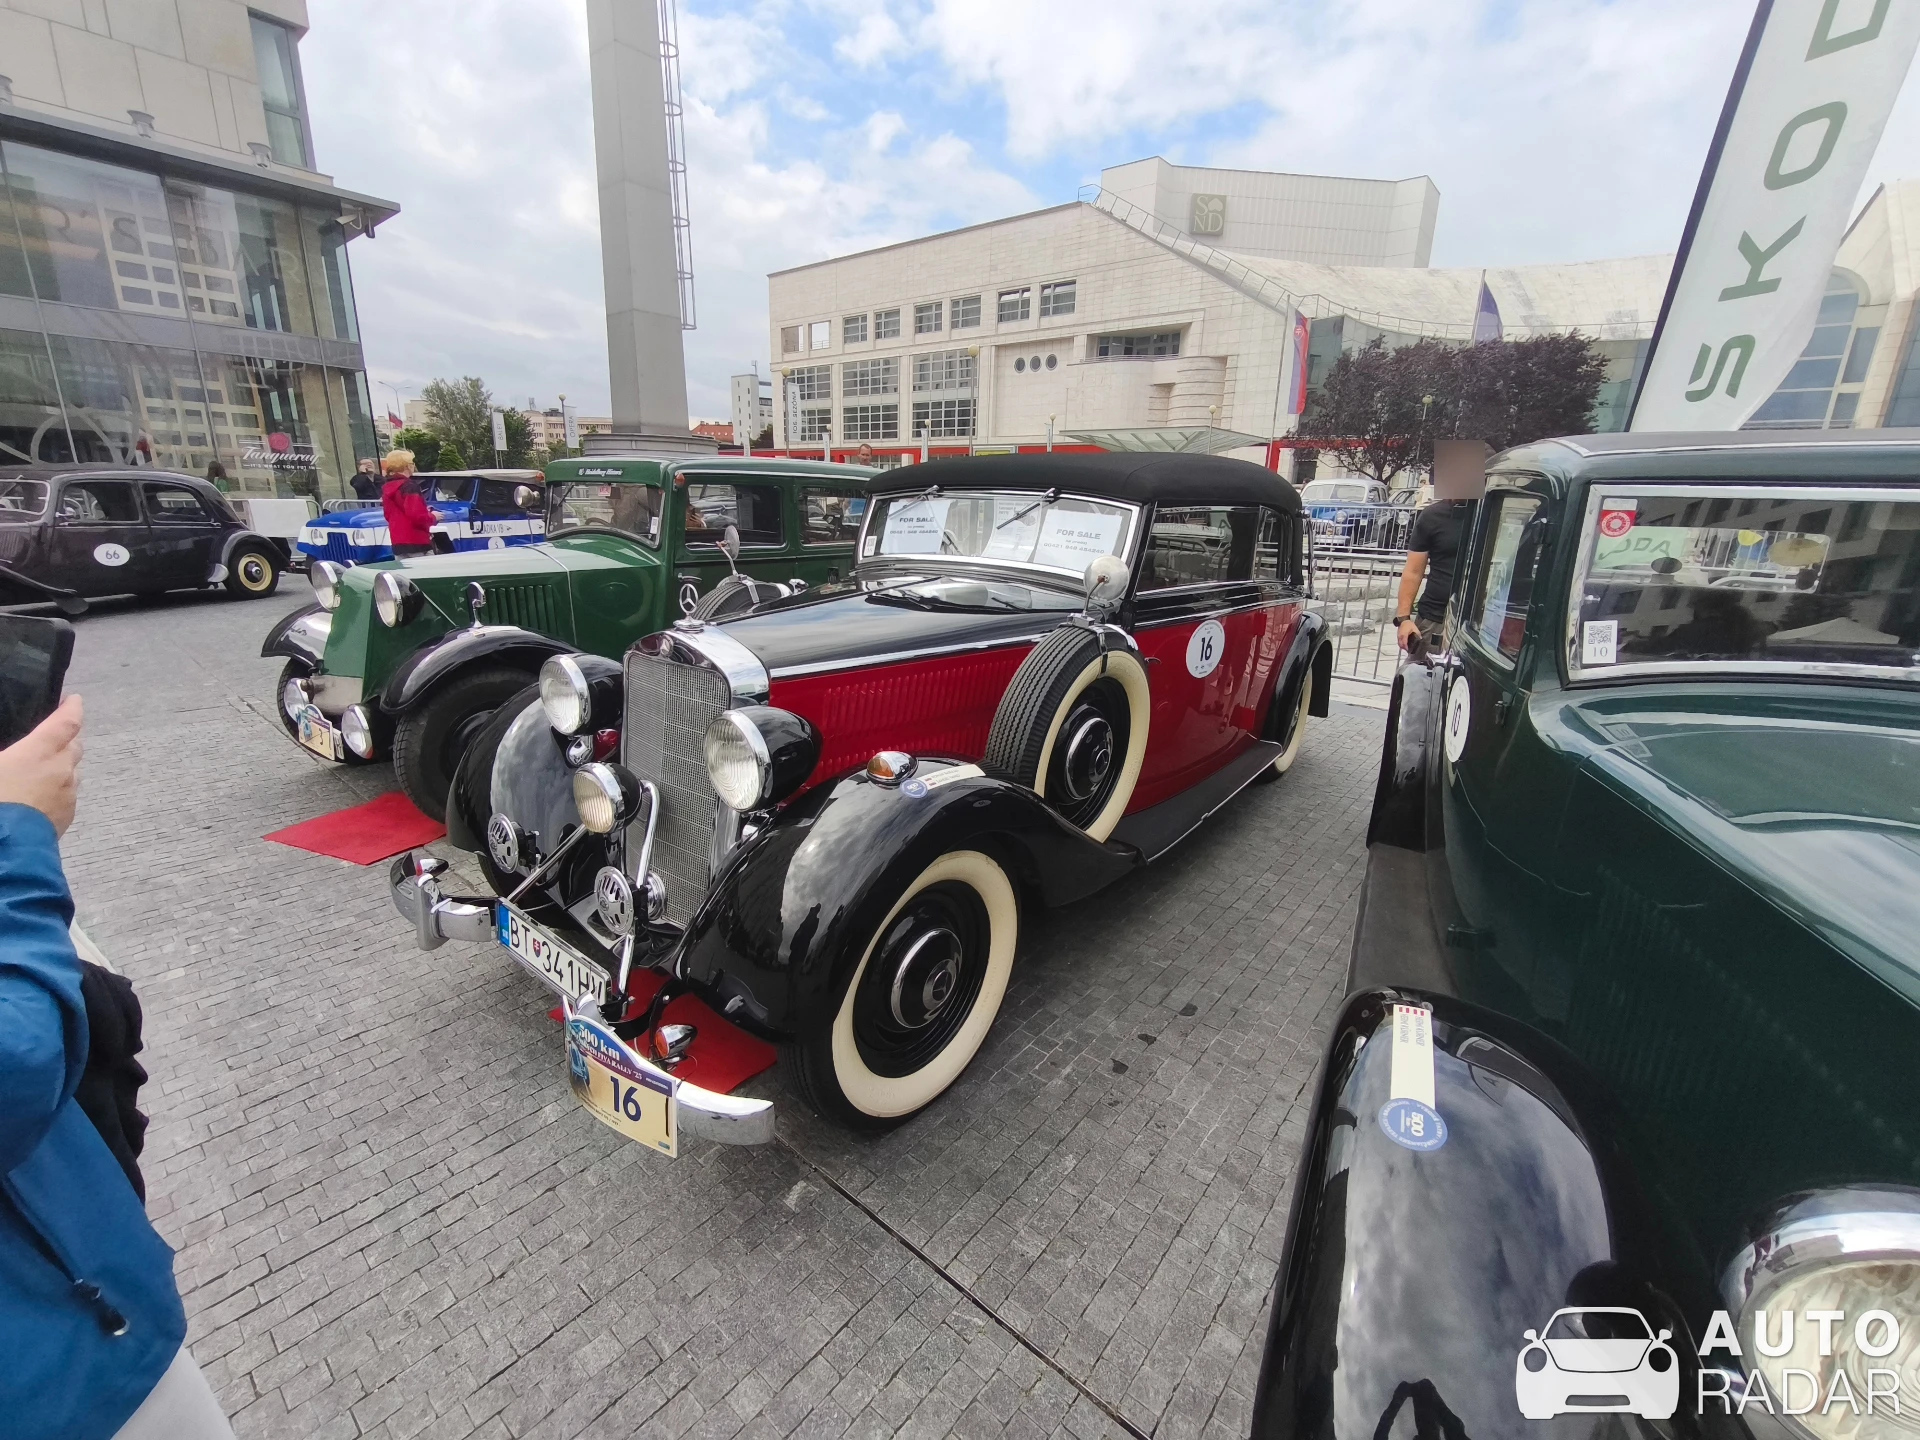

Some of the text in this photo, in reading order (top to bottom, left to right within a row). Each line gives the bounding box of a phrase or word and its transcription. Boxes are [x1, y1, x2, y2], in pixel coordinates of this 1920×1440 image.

[241, 446, 319, 465] Tanqueray
[1056, 528, 1102, 540] FOR SALE
[105, 550, 120, 560] 66
[1200, 636, 1213, 661] 16
[1593, 646, 1608, 657] 10
[510, 916, 531, 957] BT
[579, 1024, 599, 1048] 500
[600, 1038, 621, 1062] km
[611, 1060, 633, 1076] RALLY
[610, 1075, 642, 1122] 16
[1411, 1111, 1424, 1137] 500
